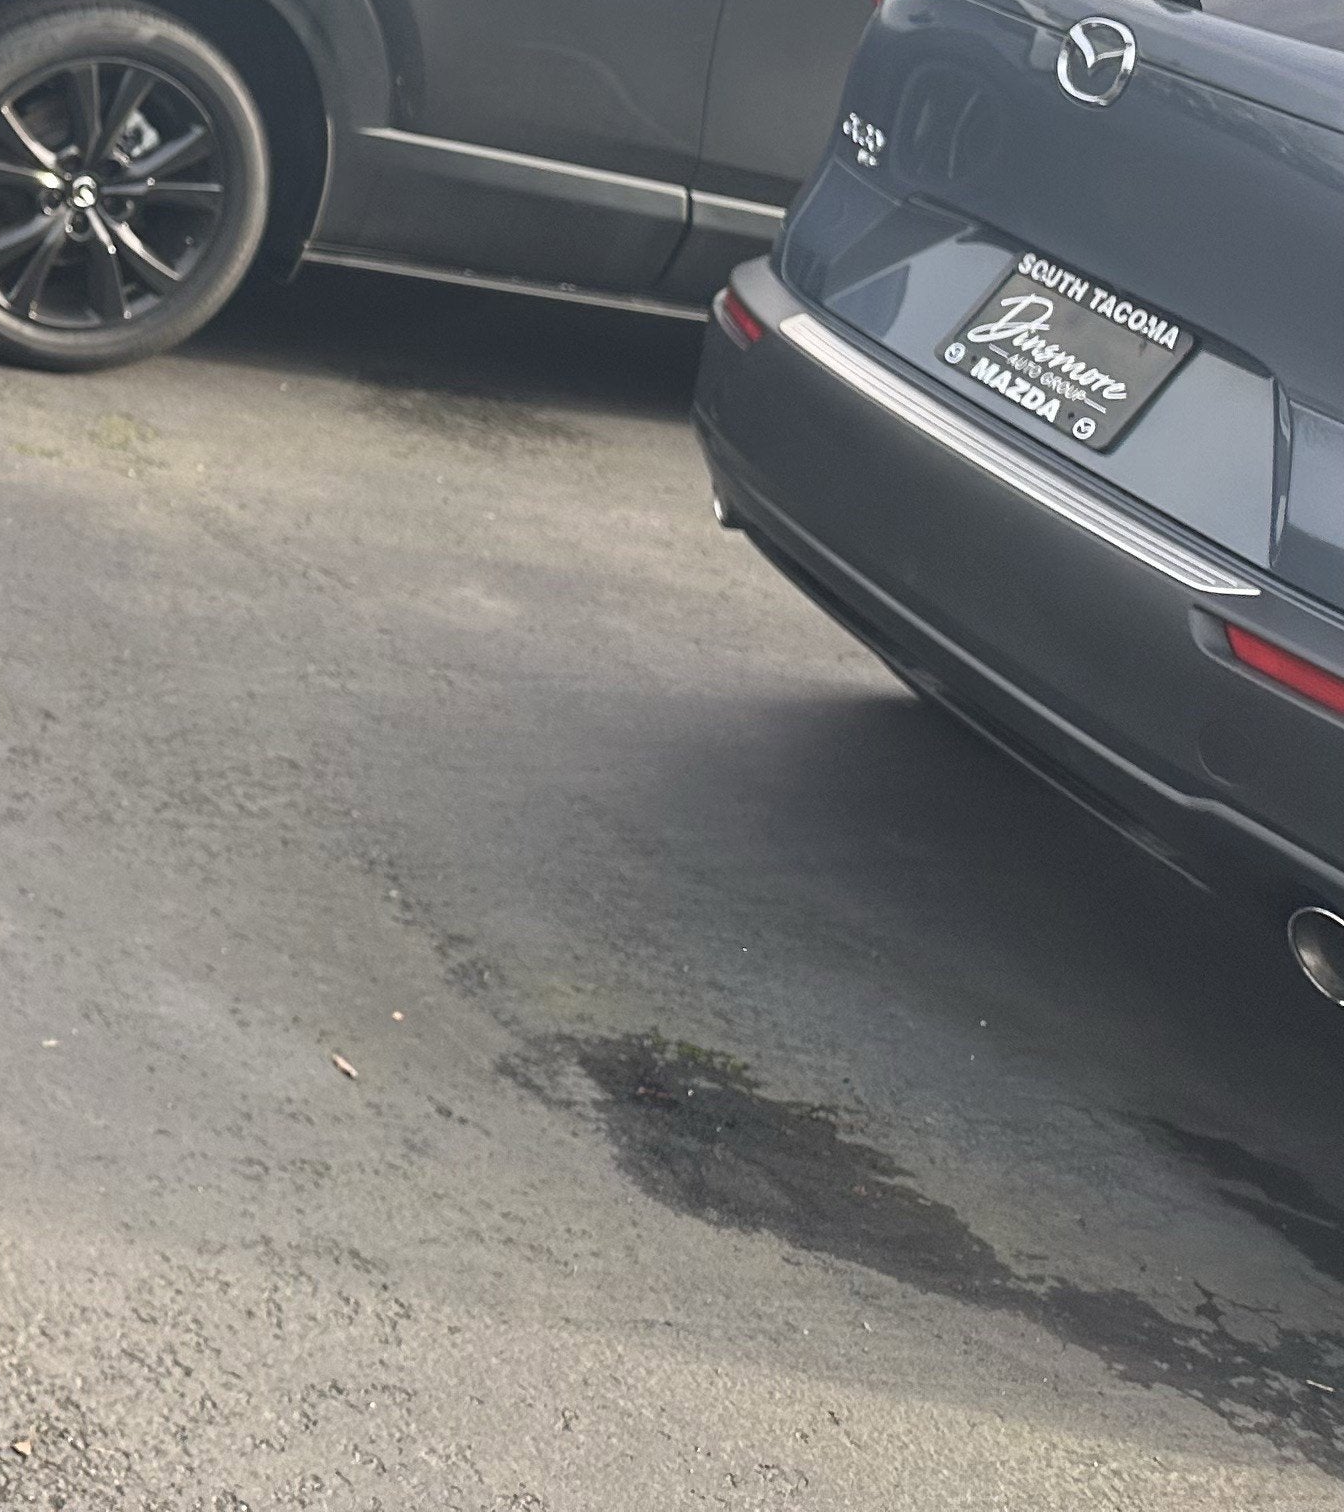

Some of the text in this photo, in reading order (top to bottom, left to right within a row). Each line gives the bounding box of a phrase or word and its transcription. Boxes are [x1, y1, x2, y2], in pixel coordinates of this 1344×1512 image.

[1018, 253, 1180, 349] SOUTH TACOMA
[967, 293, 1127, 400] Dinsmore
[1006, 351, 1087, 401] AUTO GROUP
[970, 356, 1061, 423] MAZDA
